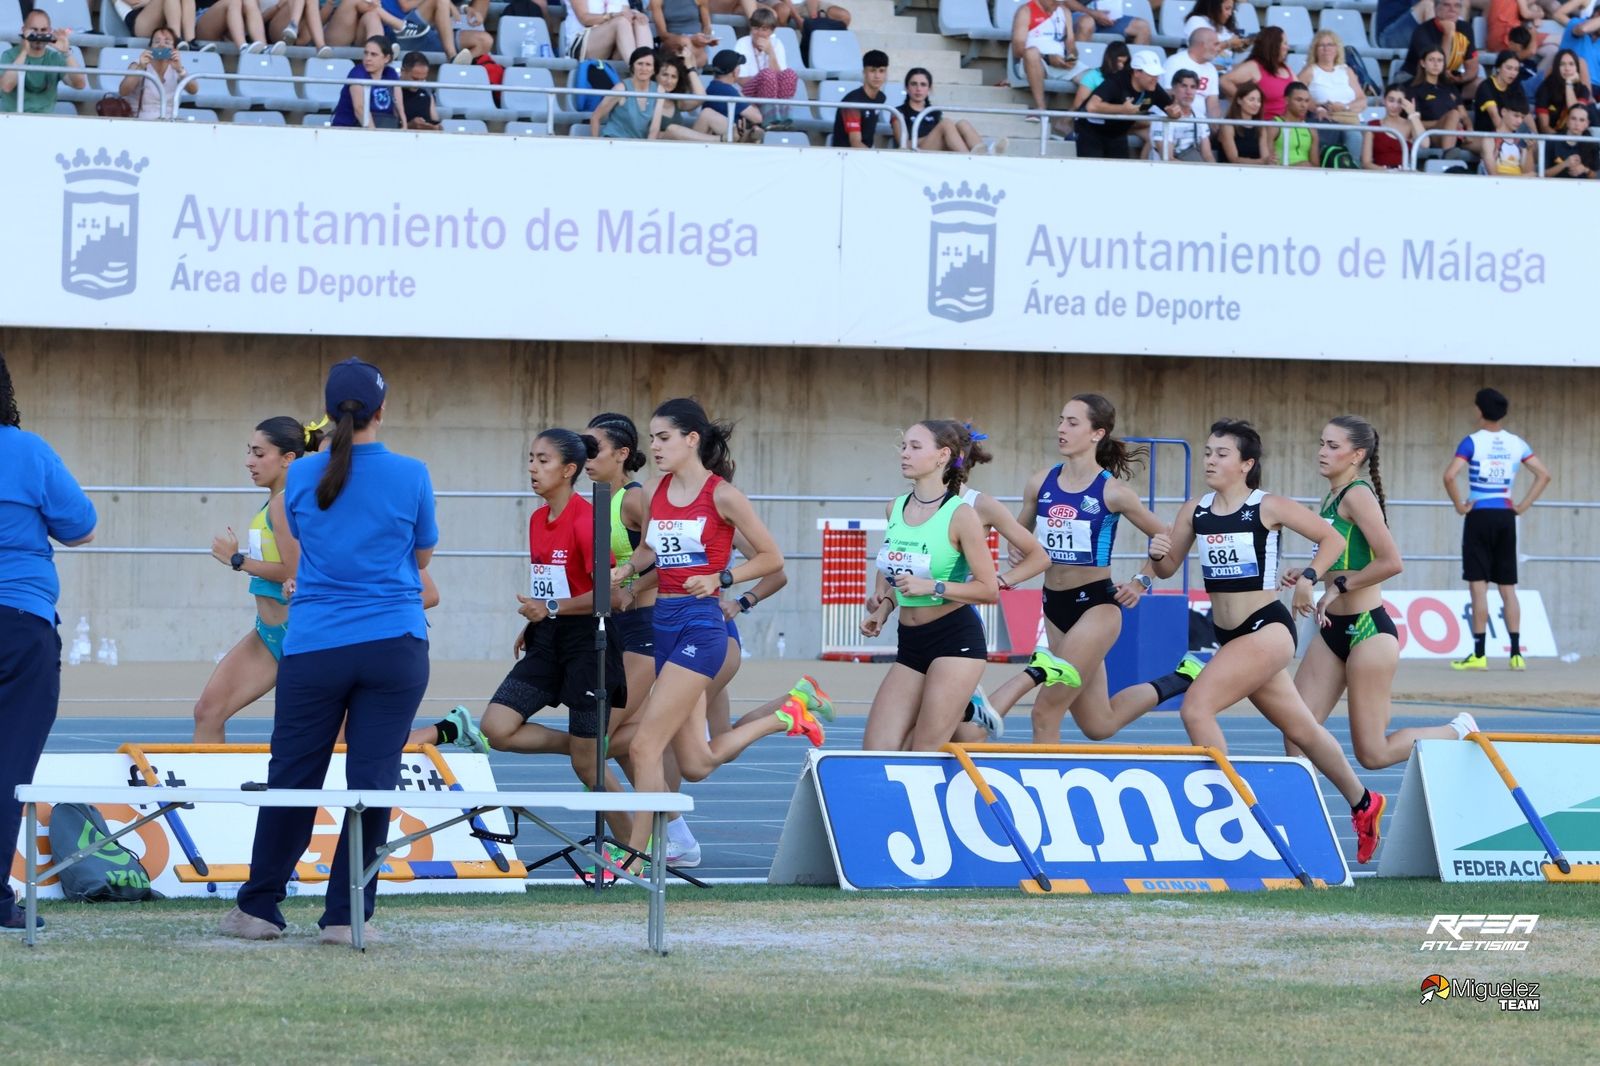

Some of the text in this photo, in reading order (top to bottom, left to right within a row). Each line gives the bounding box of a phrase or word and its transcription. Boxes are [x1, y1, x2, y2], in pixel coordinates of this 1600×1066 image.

[172, 193, 759, 267] Ayuntamiento de Málaga
[170, 253, 416, 303] Área de Deporte
[1026, 223, 1546, 293] Ayuntamiento de Málaga
[1023, 279, 1241, 326] Área de Deporte
[660, 536, 682, 553] 33
[1047, 532, 1073, 549] 611
[1208, 548, 1240, 565] 684
[884, 764, 1290, 880] Joma
